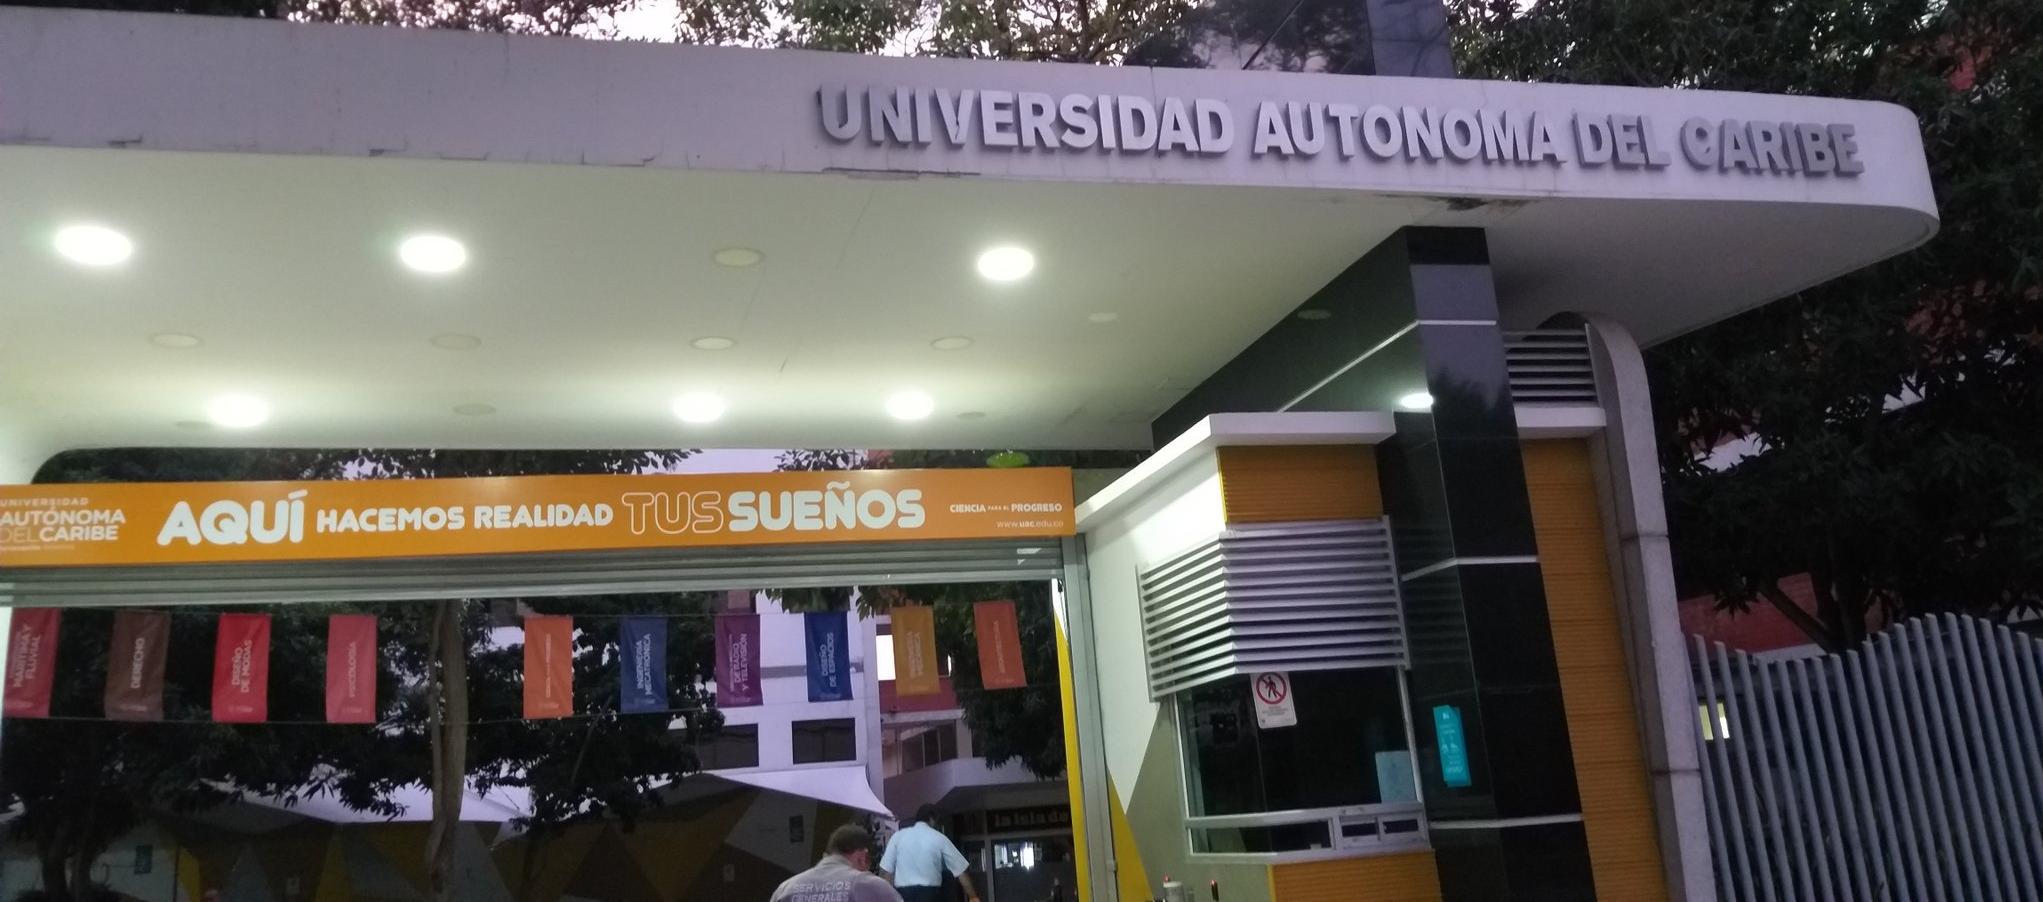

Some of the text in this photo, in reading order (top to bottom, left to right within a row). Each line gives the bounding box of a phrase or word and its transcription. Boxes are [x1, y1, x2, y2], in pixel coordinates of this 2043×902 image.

[818, 85, 1866, 177] UNIVERSIDAD AUTONOMA DEL CARIBE
[0, 497, 90, 507] UNIVERSIDAD
[949, 504, 987, 513] CIENCIA
[1011, 503, 1063, 512] PROGRESO
[0, 506, 126, 527] AUTÓNOMA
[157, 480, 926, 546] AQUÍ HACEMOS REALIDAD TUS SUEÑOS
[39, 525, 119, 542] CARIBE
[130, 637, 145, 689] DERECHO
[241, 639, 253, 693] DE MODAS
[732, 643, 741, 670] RADIO
[742, 684, 750, 692] Y
[829, 674, 837, 688] DE
[793, 881, 852, 893] SERVICIOS
